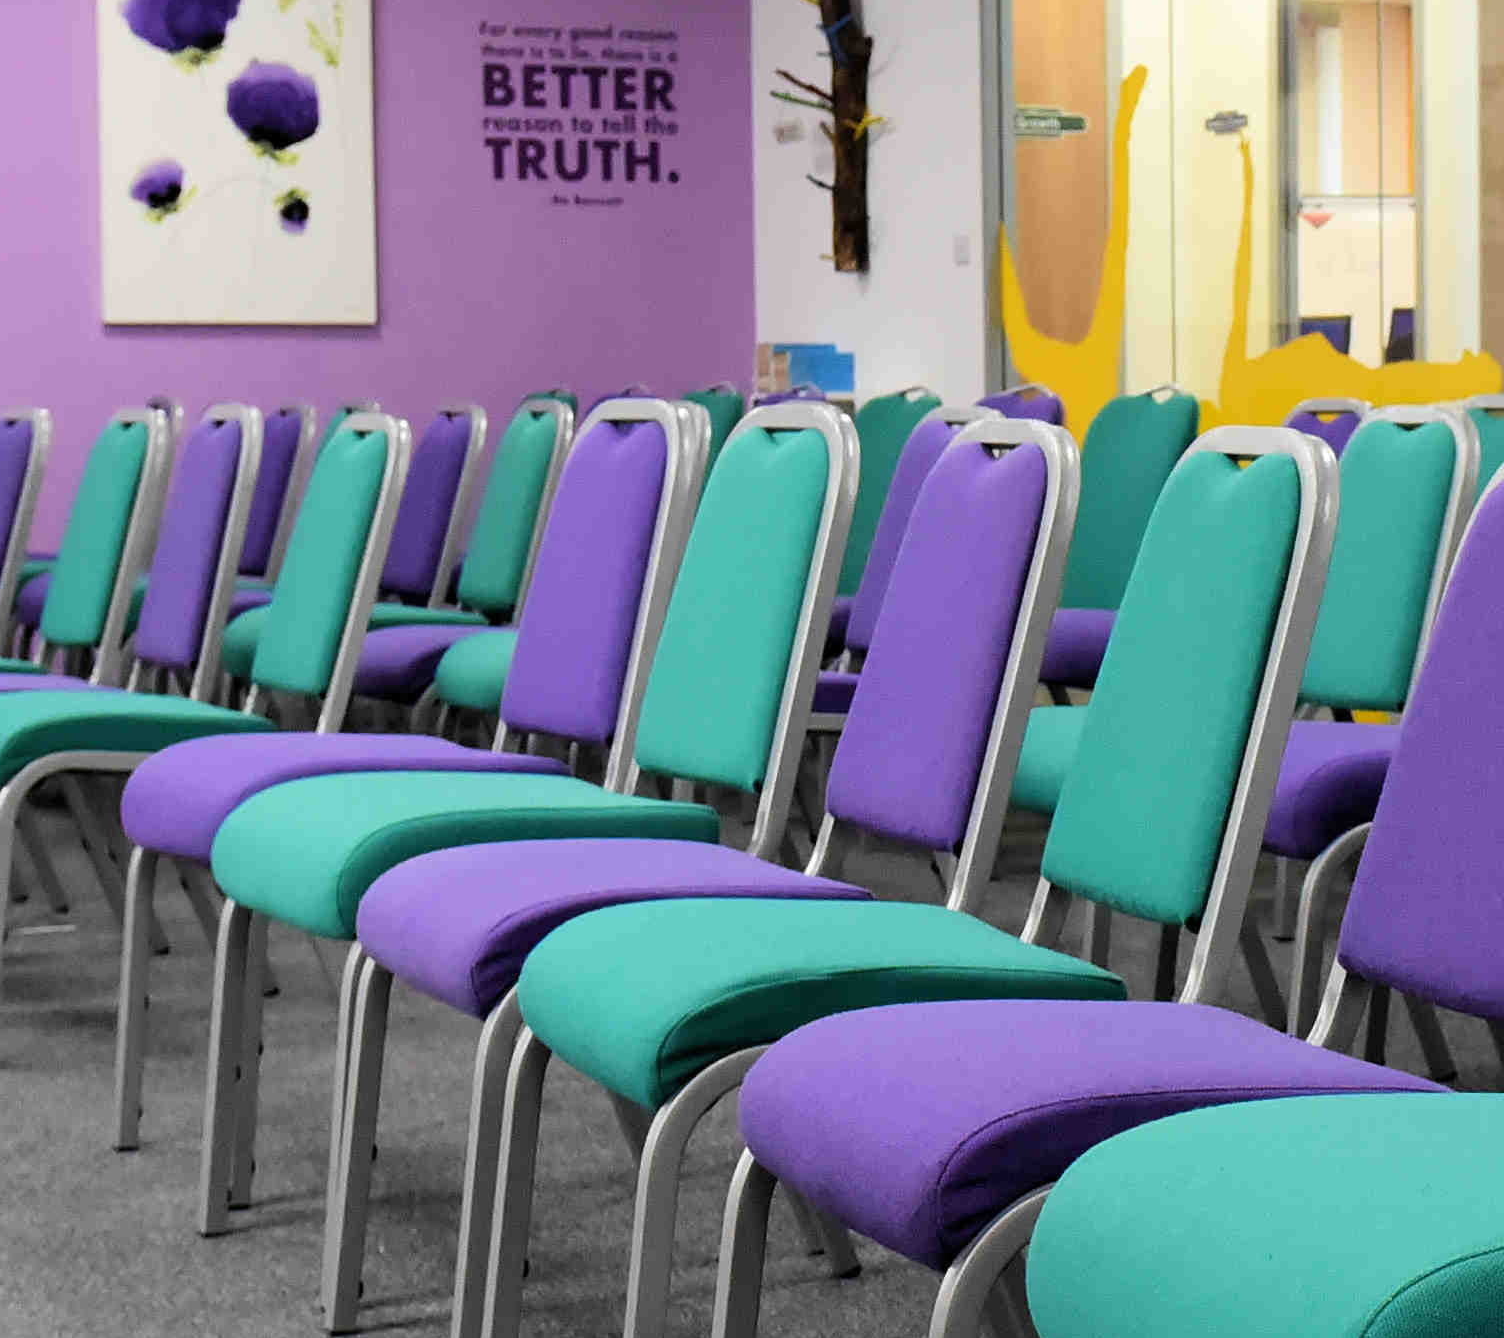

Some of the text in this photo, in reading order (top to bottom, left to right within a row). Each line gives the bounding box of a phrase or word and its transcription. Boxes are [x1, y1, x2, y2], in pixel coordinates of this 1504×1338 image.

[482, 63, 677, 112] BETTER
[483, 115, 679, 136] reason to tell the
[483, 137, 680, 184] TRUTH.
